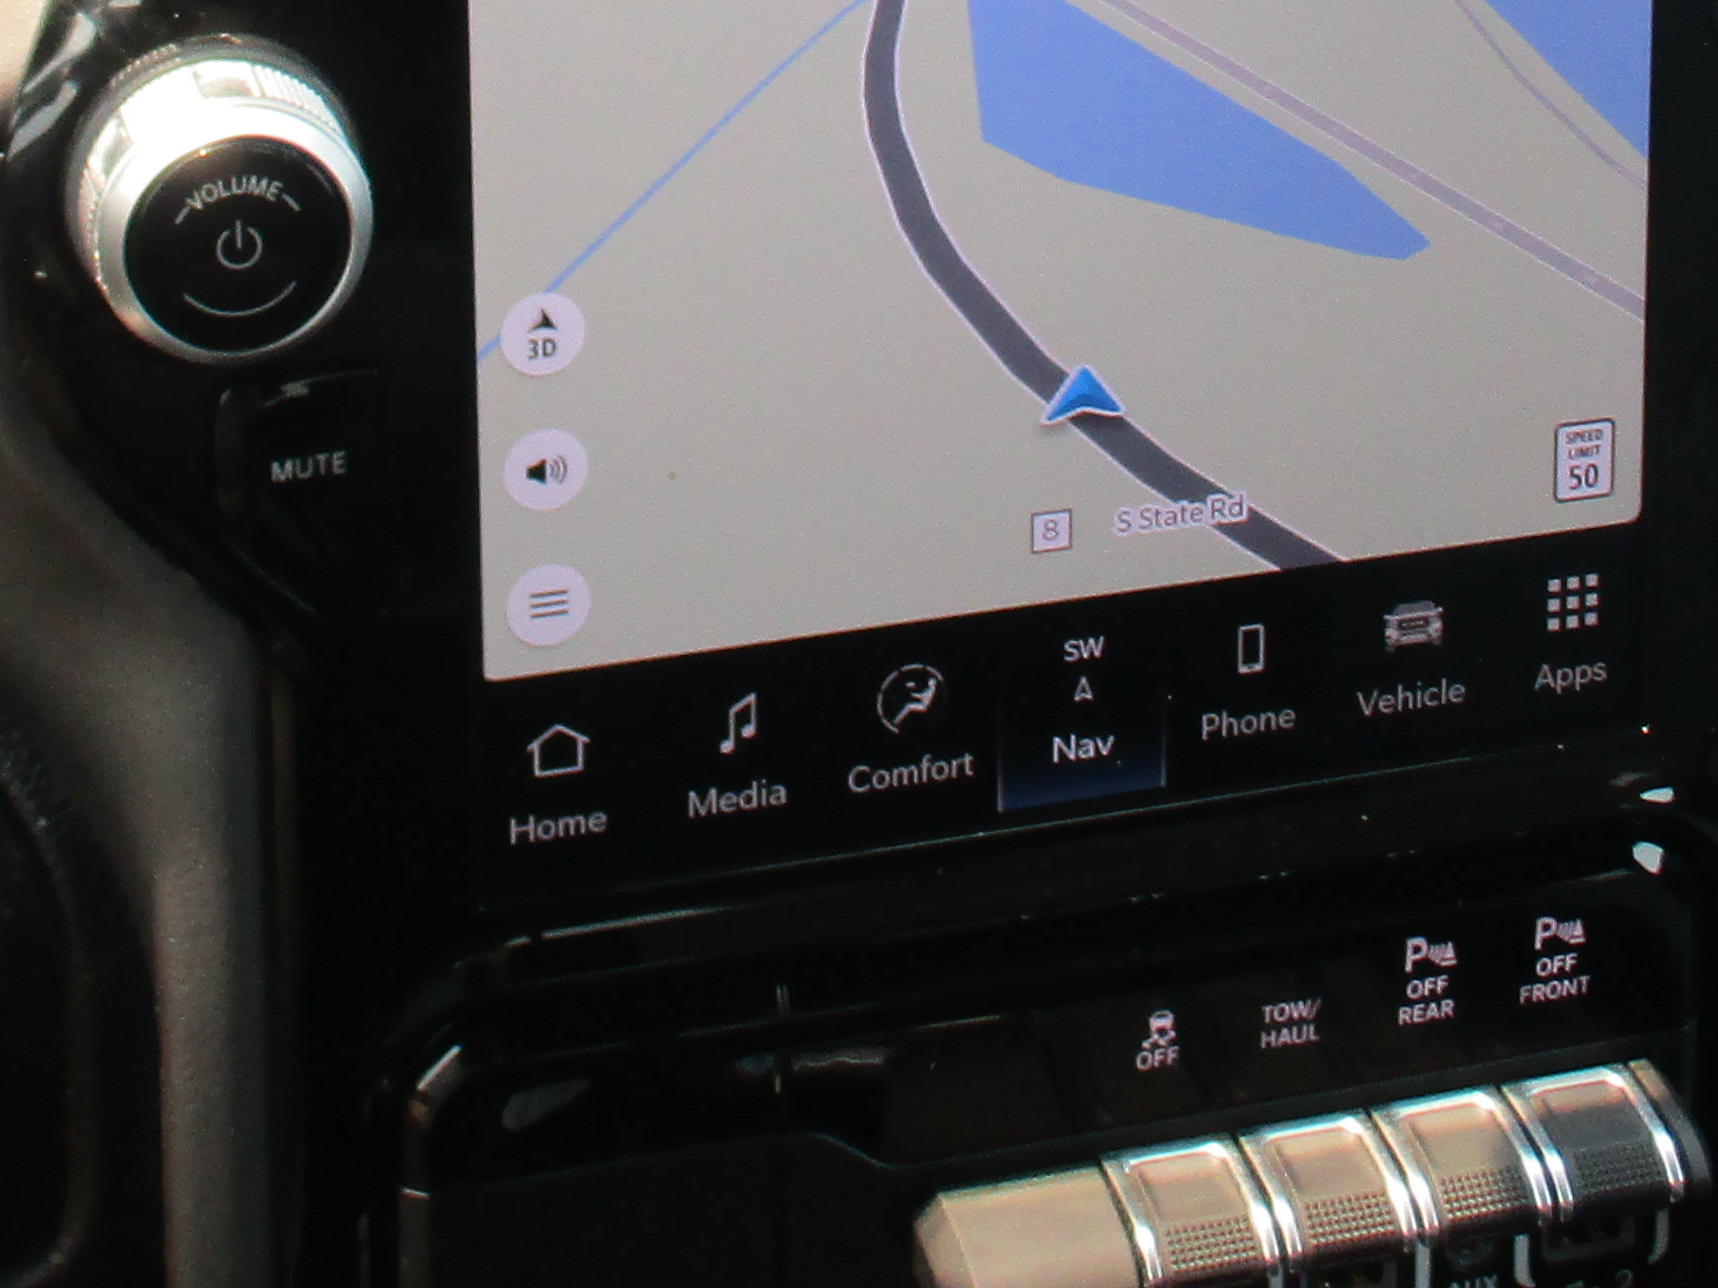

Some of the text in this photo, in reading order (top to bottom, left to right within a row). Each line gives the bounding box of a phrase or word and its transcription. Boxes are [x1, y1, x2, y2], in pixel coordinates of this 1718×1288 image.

[186, 177, 285, 213] VOLUME
[527, 338, 557, 360] 3D
[271, 450, 348, 485] MUTE
[1569, 463, 1599, 490] 50
[1116, 494, 1244, 533] S State Rd
[1042, 519, 1059, 540] 8
[1063, 636, 1105, 662] SW
[1534, 660, 1609, 693] Apps
[1358, 679, 1466, 718] Vehicle
[1201, 705, 1296, 741] Phone
[1052, 734, 1115, 764] Nav
[848, 752, 975, 793] Comfort
[689, 782, 788, 819] Media
[509, 810, 607, 845] Home
[1535, 953, 1578, 977] OFF
[1407, 976, 1449, 1000] OFF
[1519, 976, 1591, 1004] FRONT
[1261, 998, 1322, 1024] TOW/
[1398, 1000, 1456, 1025] REAR
[1260, 1025, 1320, 1049] HAUL
[1136, 1046, 1179, 1071] OFF
